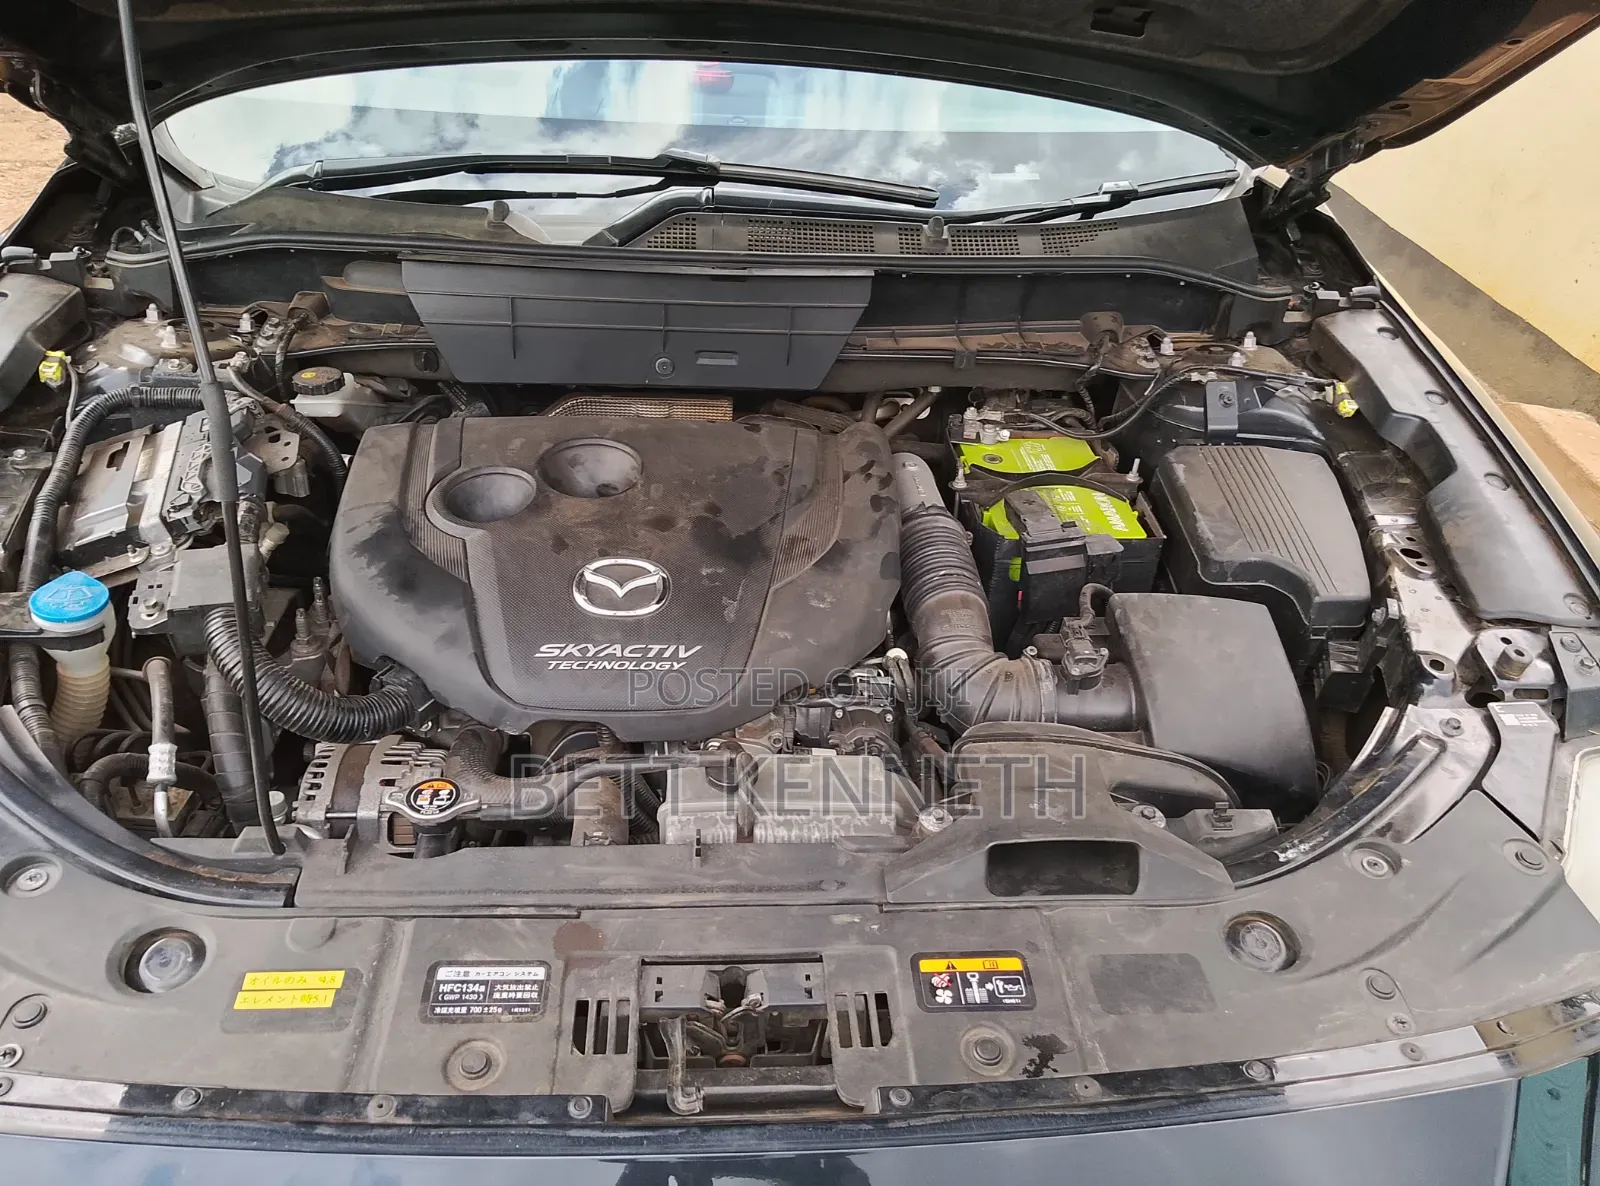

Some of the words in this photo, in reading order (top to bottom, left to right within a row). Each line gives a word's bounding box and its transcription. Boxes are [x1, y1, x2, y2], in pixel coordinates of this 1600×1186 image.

[1092, 492, 1128, 532] AMARON
[534, 643, 702, 658] SKYACTIV
[547, 660, 687, 670] TECHNOLOGY
[445, 970, 471, 978] ご注意
[439, 983, 485, 993] HFC134a
